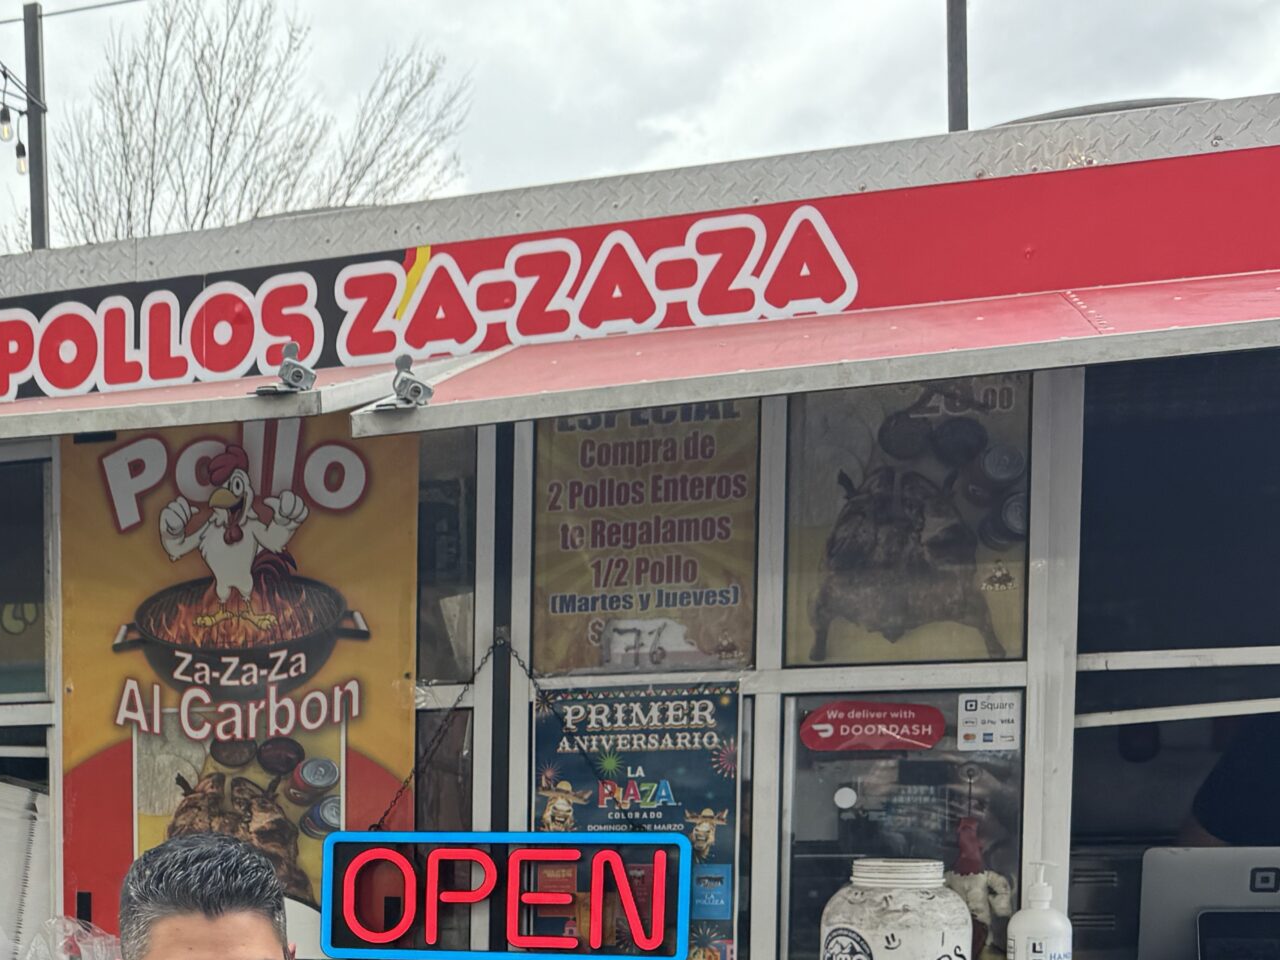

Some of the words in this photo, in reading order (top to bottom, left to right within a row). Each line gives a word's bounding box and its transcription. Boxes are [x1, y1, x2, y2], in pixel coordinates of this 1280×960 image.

[336, 207, 857, 364] ZA-ZA-ZA
[580, 436, 677, 469] Compra
[684, 430, 715, 461] de
[101, 419, 370, 532] Pollo
[548, 482, 563, 511] 2
[569, 478, 645, 509] Pollos
[651, 474, 747, 504] Enteros
[561, 523, 584, 550] te
[590, 516, 732, 550] Regalamos
[591, 558, 628, 588] 1/2
[635, 555, 698, 586] Pollo
[550, 592, 633, 614] (Martes
[639, 592, 651, 611] y
[655, 586, 740, 608] Jueves)
[172, 650, 308, 685] Za-Za-Za
[116, 679, 162, 735] Al
[179, 677, 362, 742] Carbon
[563, 699, 716, 732] PRIMER
[826, 709, 845, 720] We
[847, 709, 888, 720] deliver
[890, 709, 916, 719] with
[980, 701, 1015, 711] Square
[557, 731, 719, 753] ANIVERSARIO
[840, 723, 933, 736] DOORDASH
[627, 766, 645, 778] LA
[598, 779, 677, 809] PLAZA
[587, 824, 628, 832] DOMINGO
[654, 823, 684, 832] MARZO
[608, 811, 663, 820] COLORADO
[341, 846, 668, 951] OPEN
